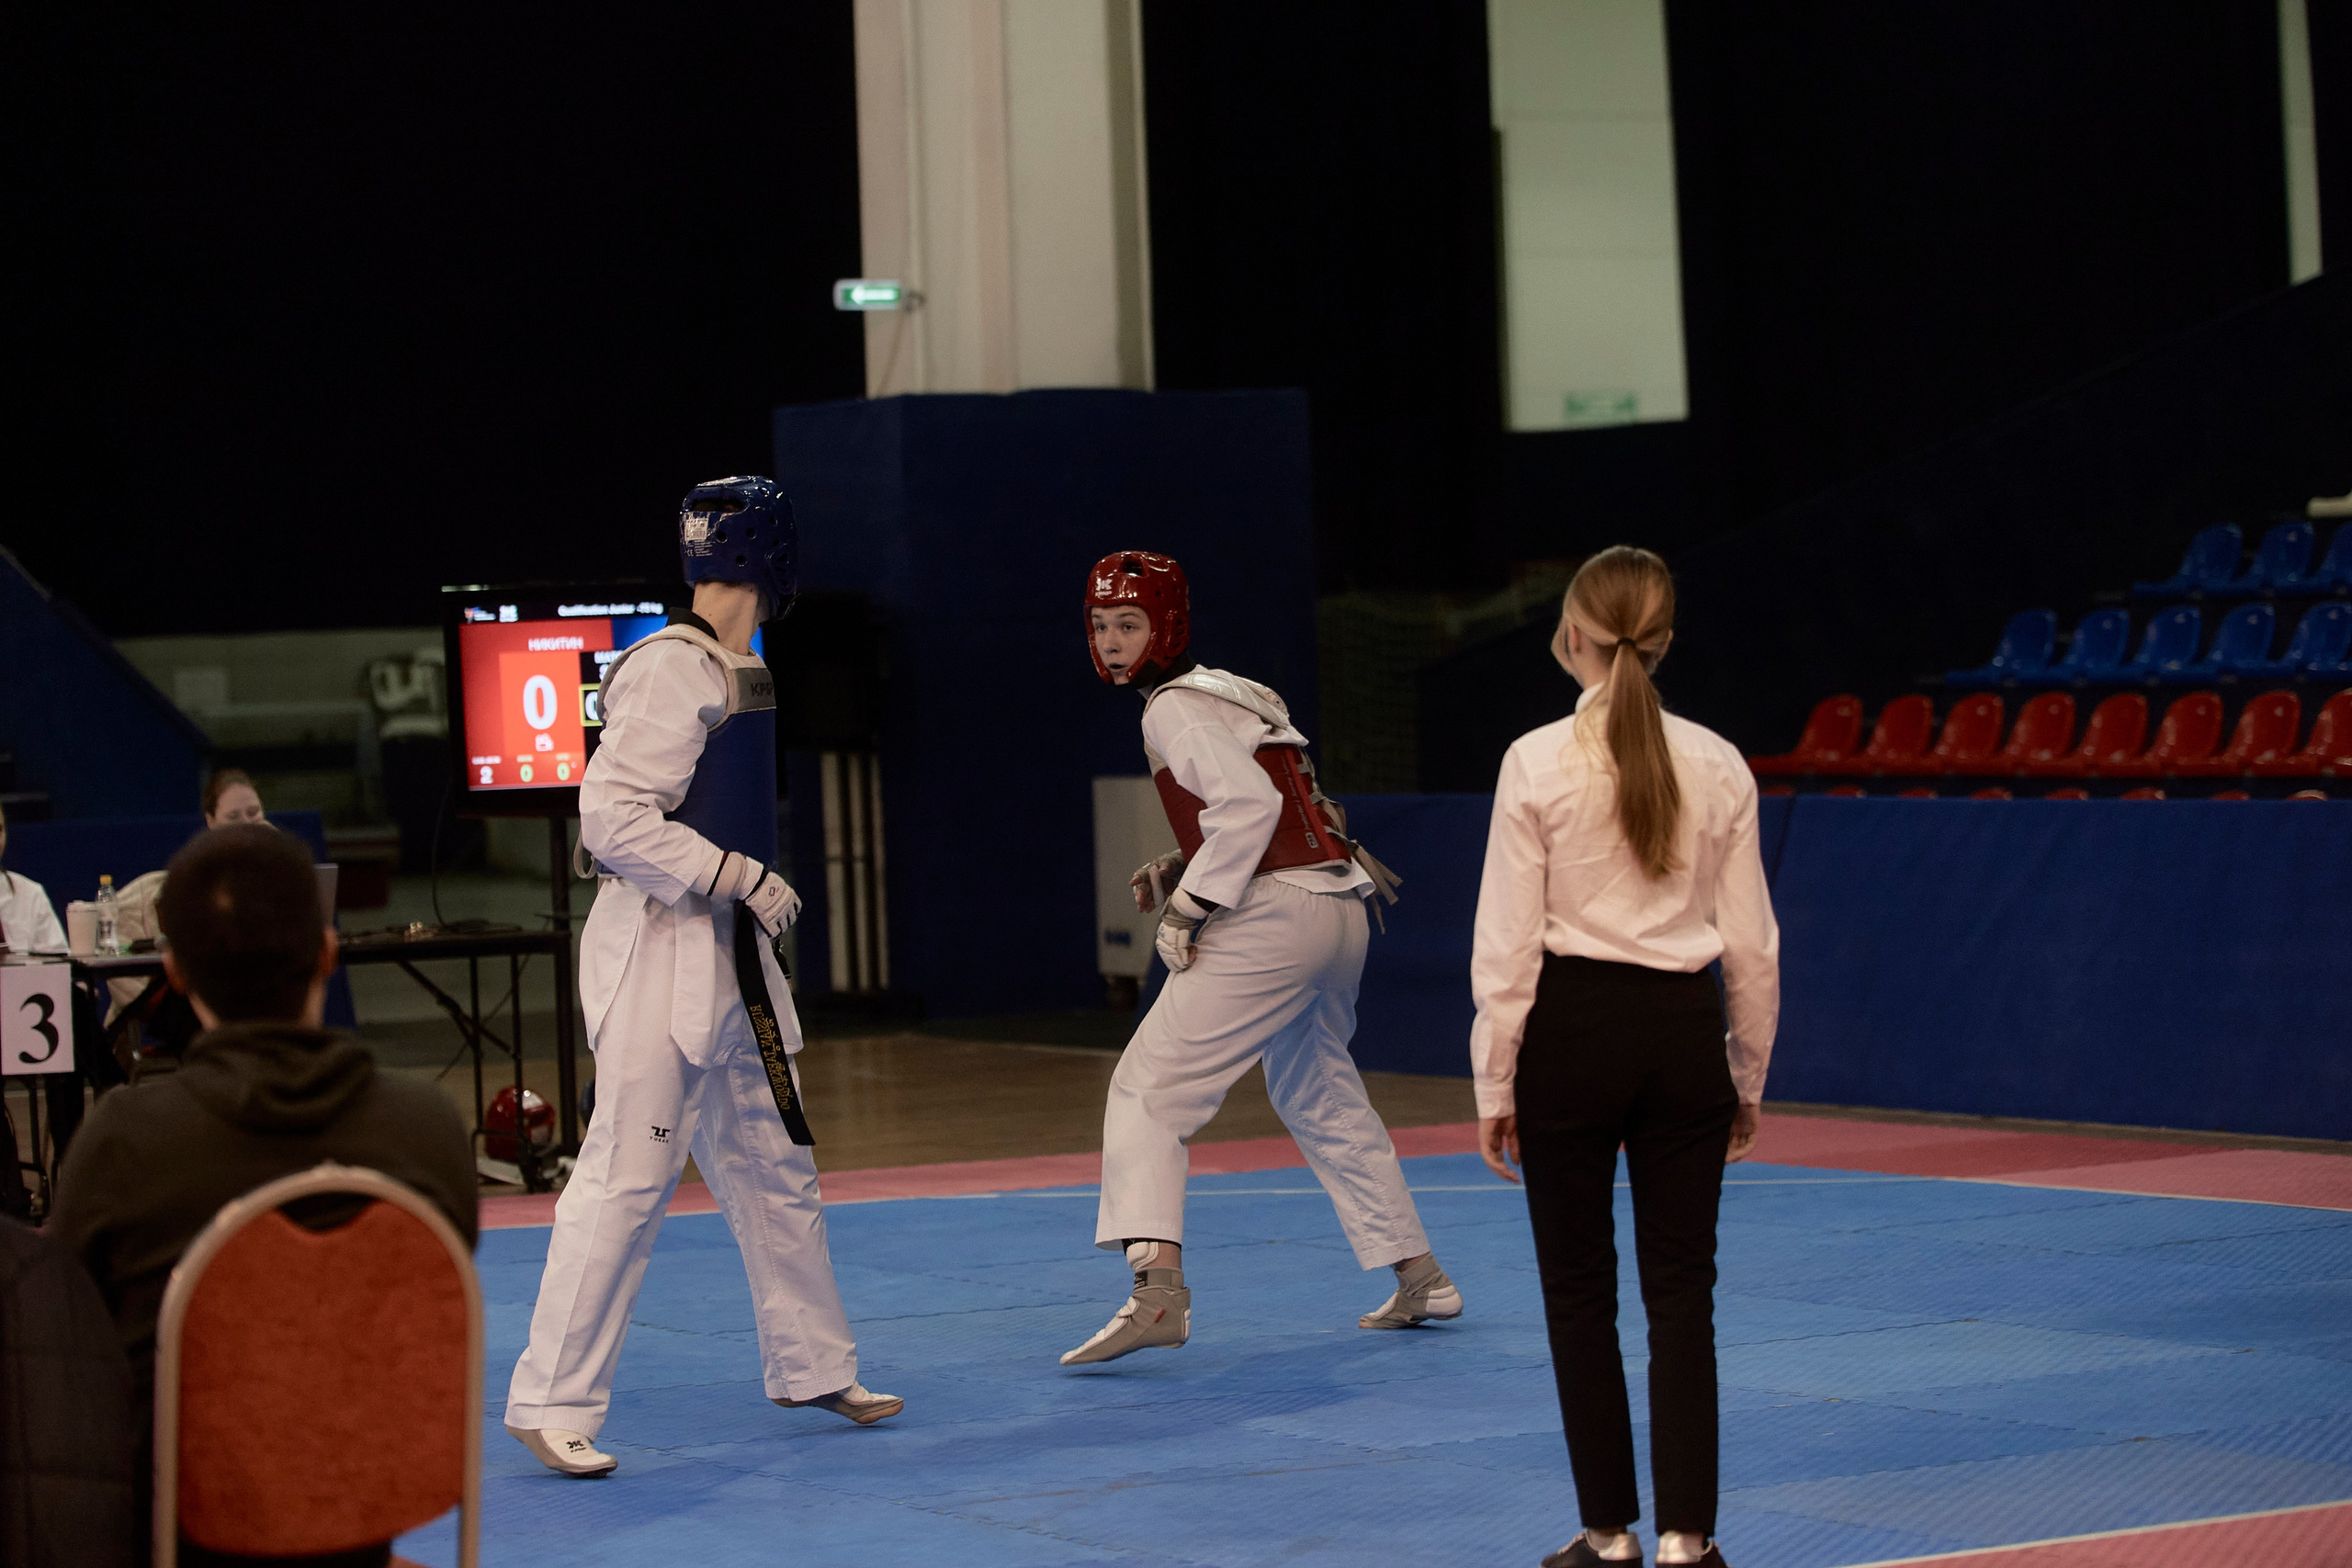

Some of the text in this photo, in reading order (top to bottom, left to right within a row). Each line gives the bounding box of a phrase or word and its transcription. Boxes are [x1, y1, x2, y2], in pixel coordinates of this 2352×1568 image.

[528, 637, 584, 651] НИКИТИН
[523, 674, 558, 730] 0
[480, 765, 494, 784] 2
[520, 763, 534, 783] 0
[557, 761, 571, 781] 0
[18, 993, 60, 1064] 3
